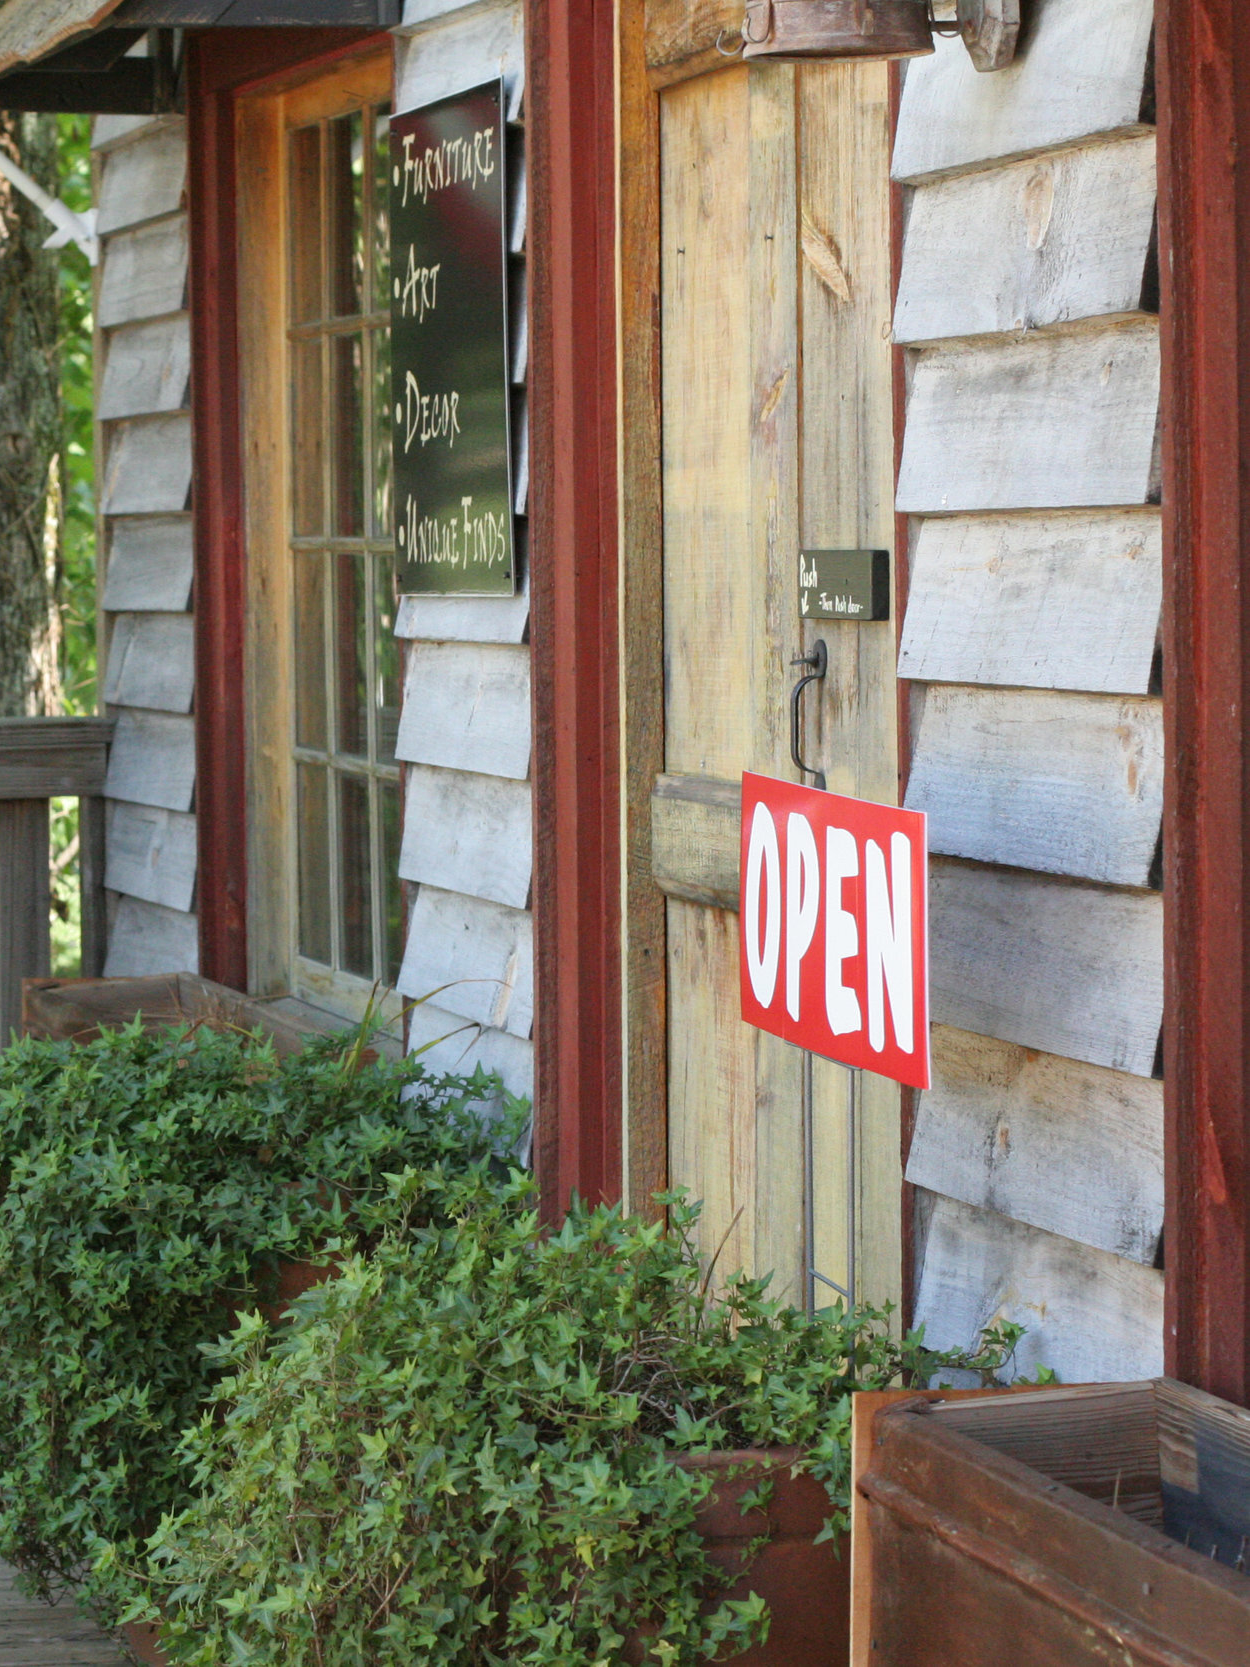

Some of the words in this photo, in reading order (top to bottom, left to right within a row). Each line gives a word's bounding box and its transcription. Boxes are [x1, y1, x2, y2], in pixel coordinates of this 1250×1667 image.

[402, 243, 440, 324] ART
[404, 370, 461, 454] DECOR
[406, 493, 459, 569] UNIQUE
[461, 496, 506, 570] FINDS
[799, 554, 818, 588] Push
[745, 801, 914, 1054] OPEN
